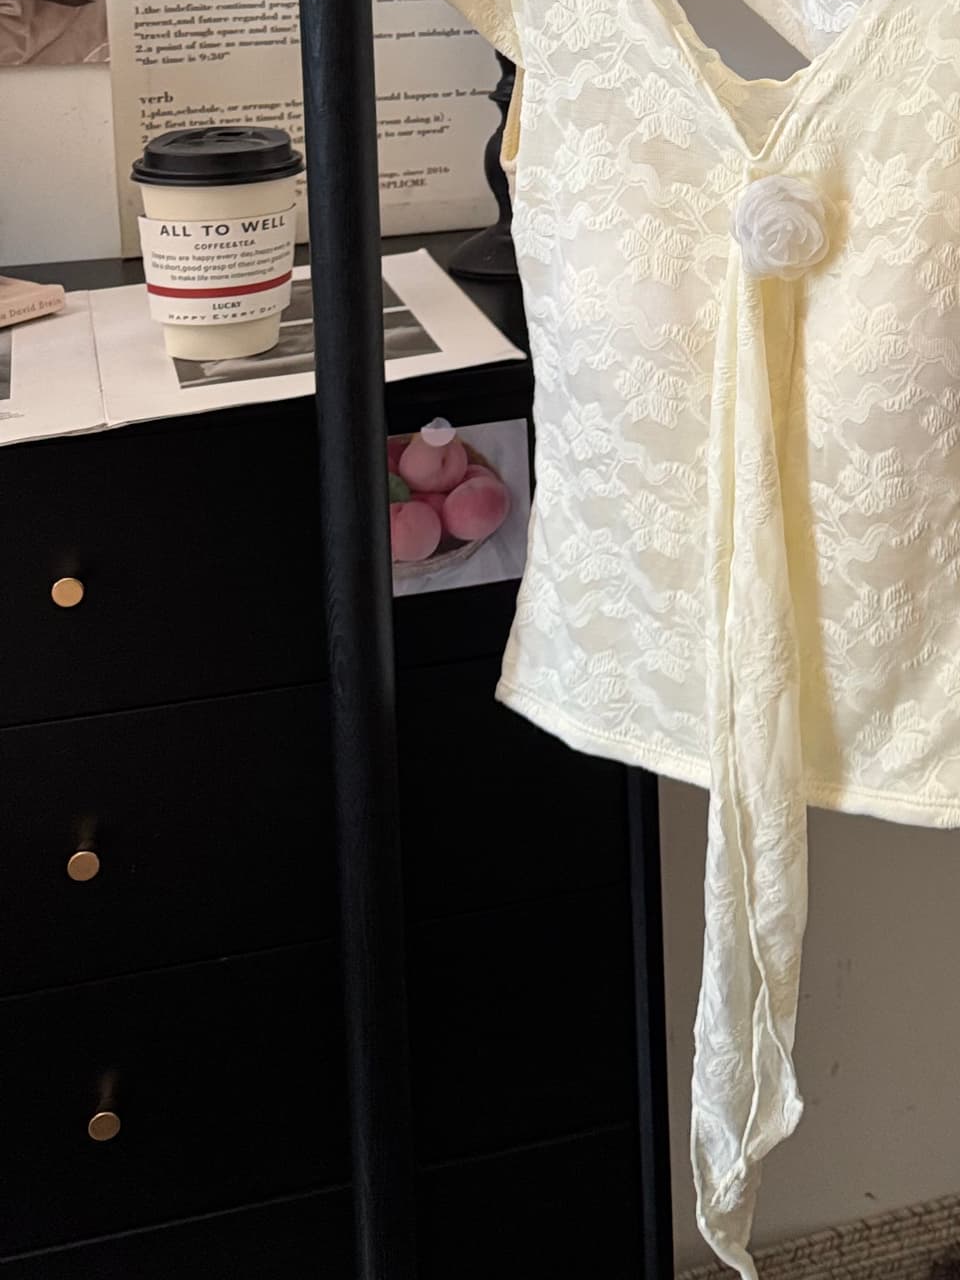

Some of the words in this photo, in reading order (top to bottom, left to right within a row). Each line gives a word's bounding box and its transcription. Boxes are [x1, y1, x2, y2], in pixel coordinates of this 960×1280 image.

[232, 12, 278, 23] regarded
[139, 91, 174, 105] verb
[159, 224, 193, 237] ALL
[201, 224, 230, 236] TO
[241, 215, 286, 234] WELL
[194, 239, 256, 251] COFFEE&TEA
